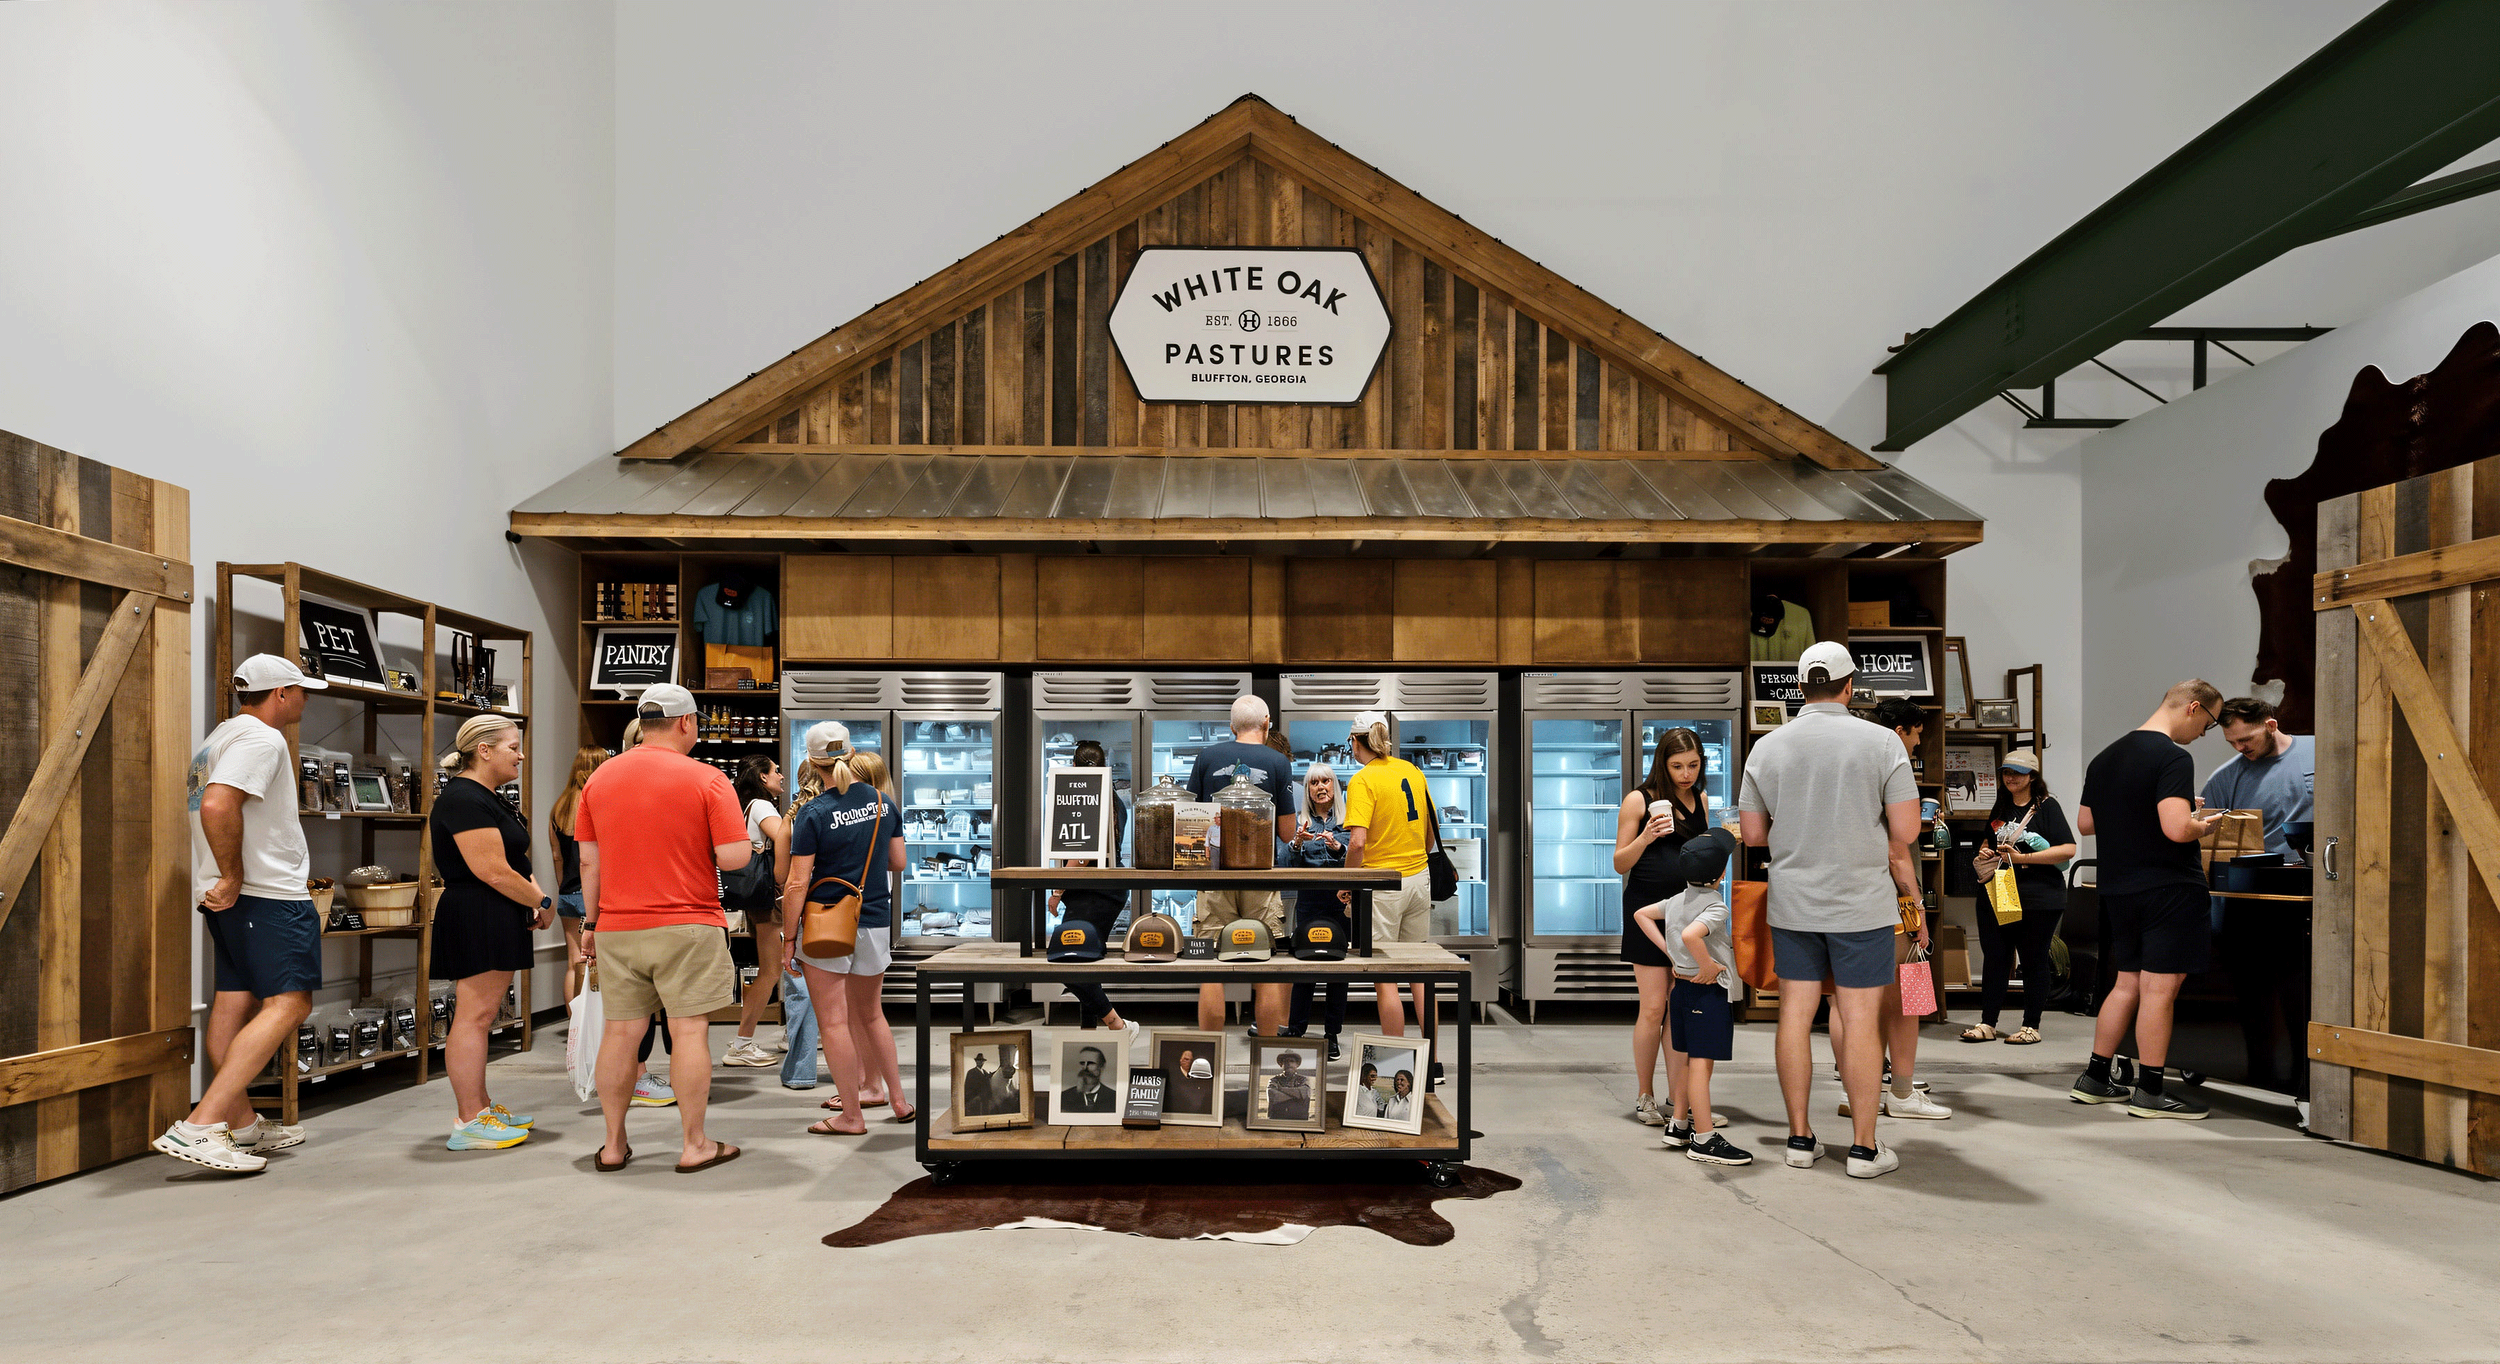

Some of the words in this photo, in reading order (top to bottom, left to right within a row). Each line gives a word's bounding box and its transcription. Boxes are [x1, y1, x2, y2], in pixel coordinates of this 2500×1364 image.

[1151, 266, 1263, 313] WHITE
[1277, 270, 1348, 317] OAK
[1205, 315, 1232, 326] EST.
[1267, 316, 1298, 327] 1866
[1165, 343, 1334, 366] PASTURES
[1191, 373, 1252, 384] BLUFFTON,
[1255, 374, 1307, 384] GEORGIA
[313, 621, 359, 655] PET
[604, 644, 671, 666] PANTRY
[1860, 653, 1914, 673] HOME
[1056, 794, 1099, 806] BLUFFTON
[1400, 777, 1419, 822] 1
[830, 808, 869, 830] ROUND
[1058, 823, 1091, 840] ATL
[1130, 1088, 1160, 1100] FAMILY
